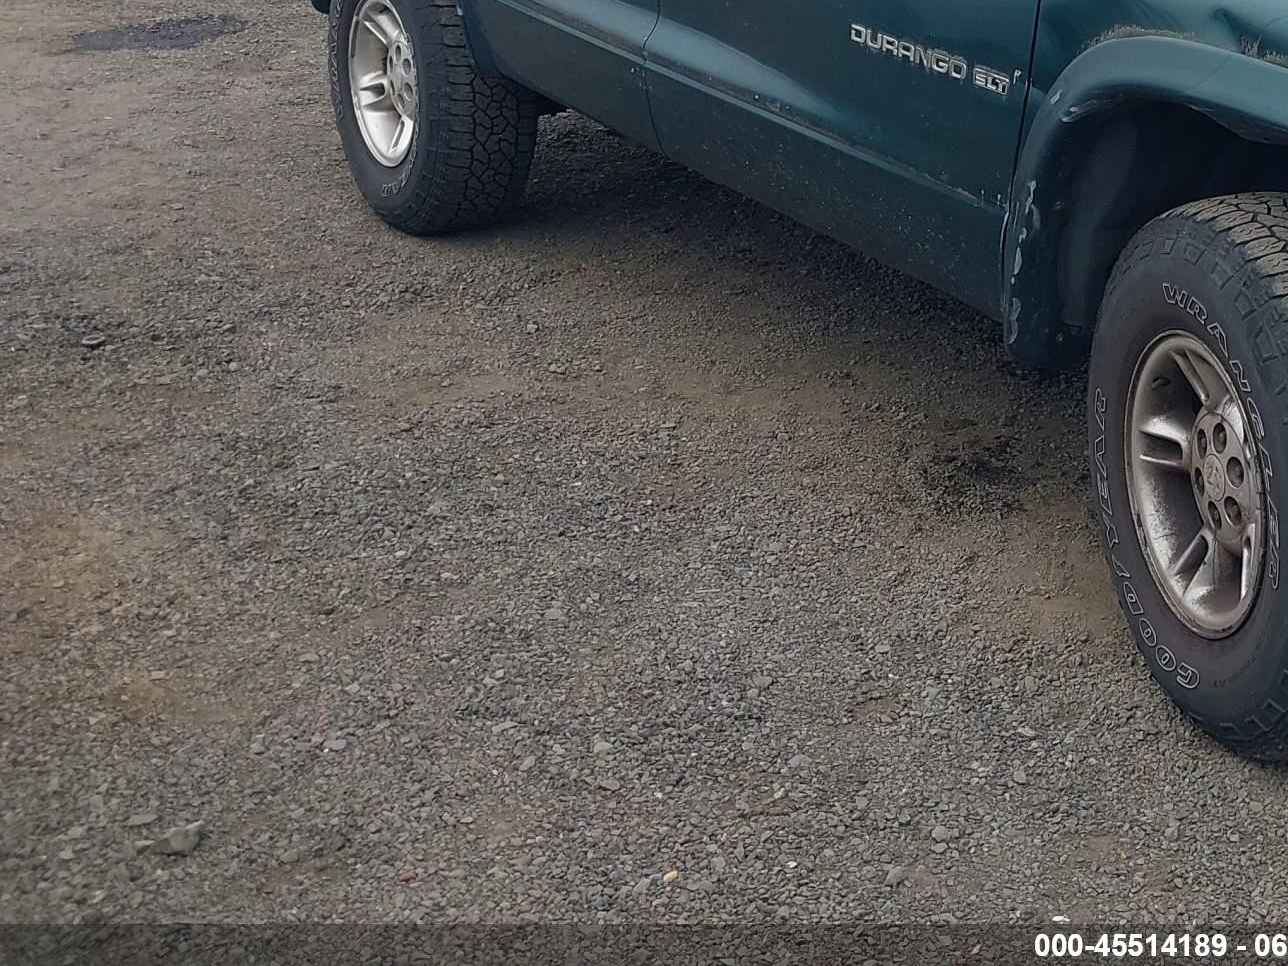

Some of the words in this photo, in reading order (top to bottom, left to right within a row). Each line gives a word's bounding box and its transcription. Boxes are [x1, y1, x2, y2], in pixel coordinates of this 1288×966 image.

[850, 22, 968, 80] DURANGO
[973, 70, 1009, 95] SLT
[1161, 282, 1280, 590] WRANGLER
